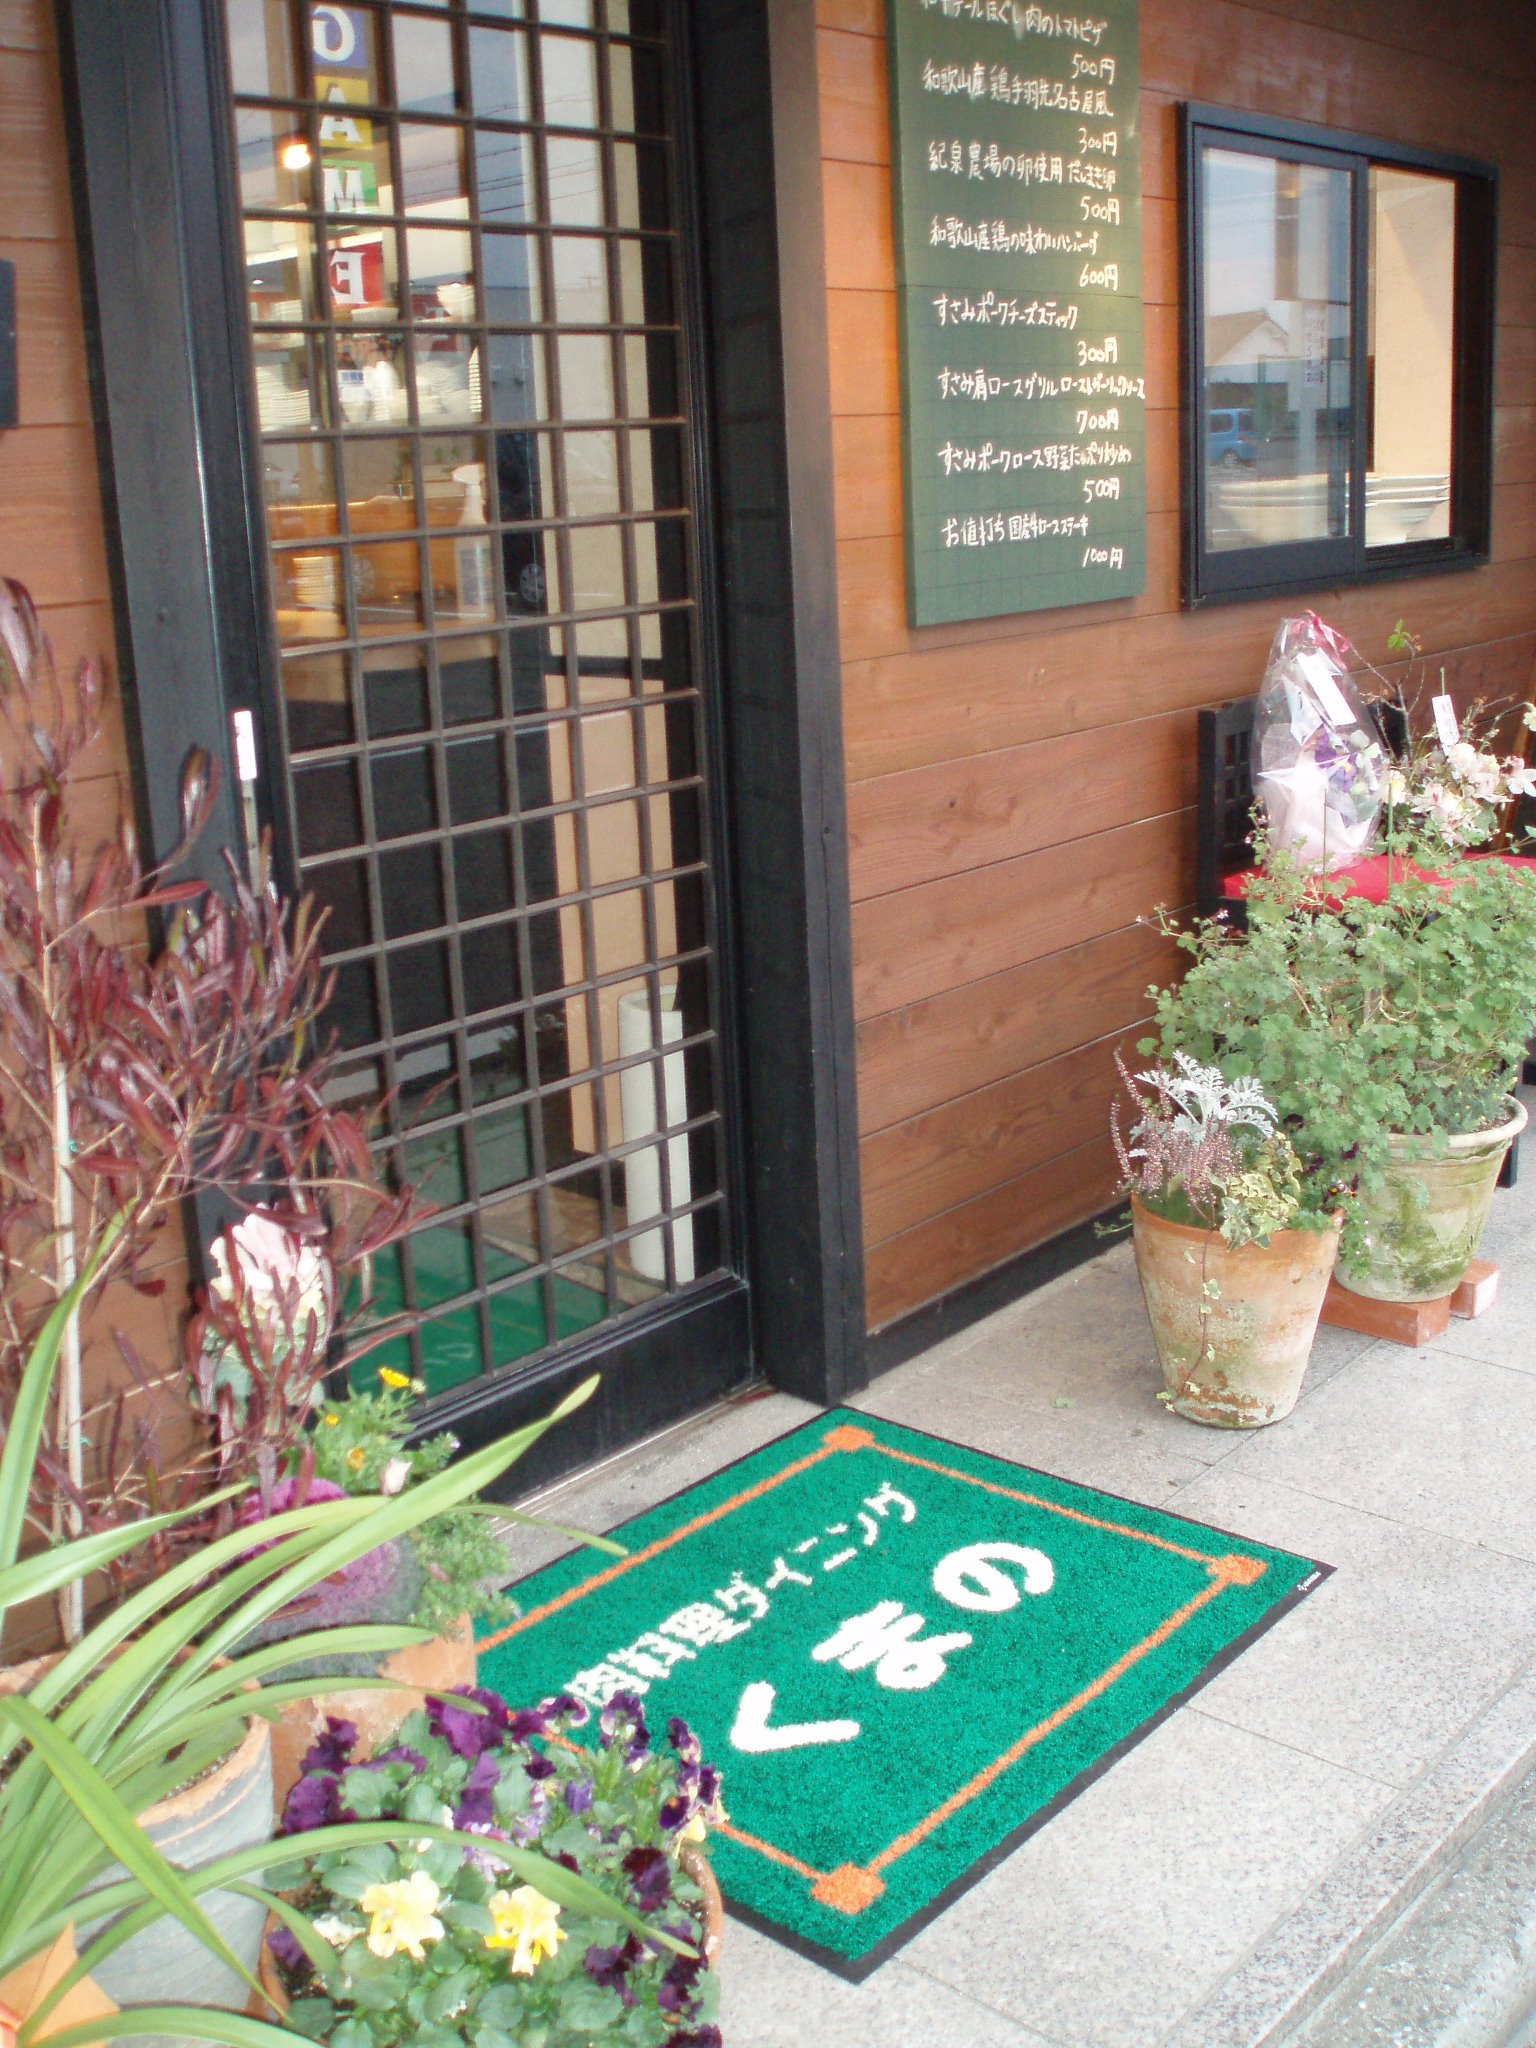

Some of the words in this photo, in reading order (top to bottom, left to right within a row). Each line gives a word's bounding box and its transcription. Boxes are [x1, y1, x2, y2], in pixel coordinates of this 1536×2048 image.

[1071, 53, 1115, 84] 500円
[1078, 127, 1117, 157] 300円
[1080, 195, 1120, 226] 500円
[1079, 263, 1118, 291] 600円
[1077, 336, 1118, 367] 300円
[1076, 407, 1119, 434] 700円
[1083, 477, 1120, 503] 500円
[1082, 547, 1123, 569] 1000円
[563, 1481, 916, 1706] 肉料理ダイニング
[729, 1542, 1055, 1753] くまの
